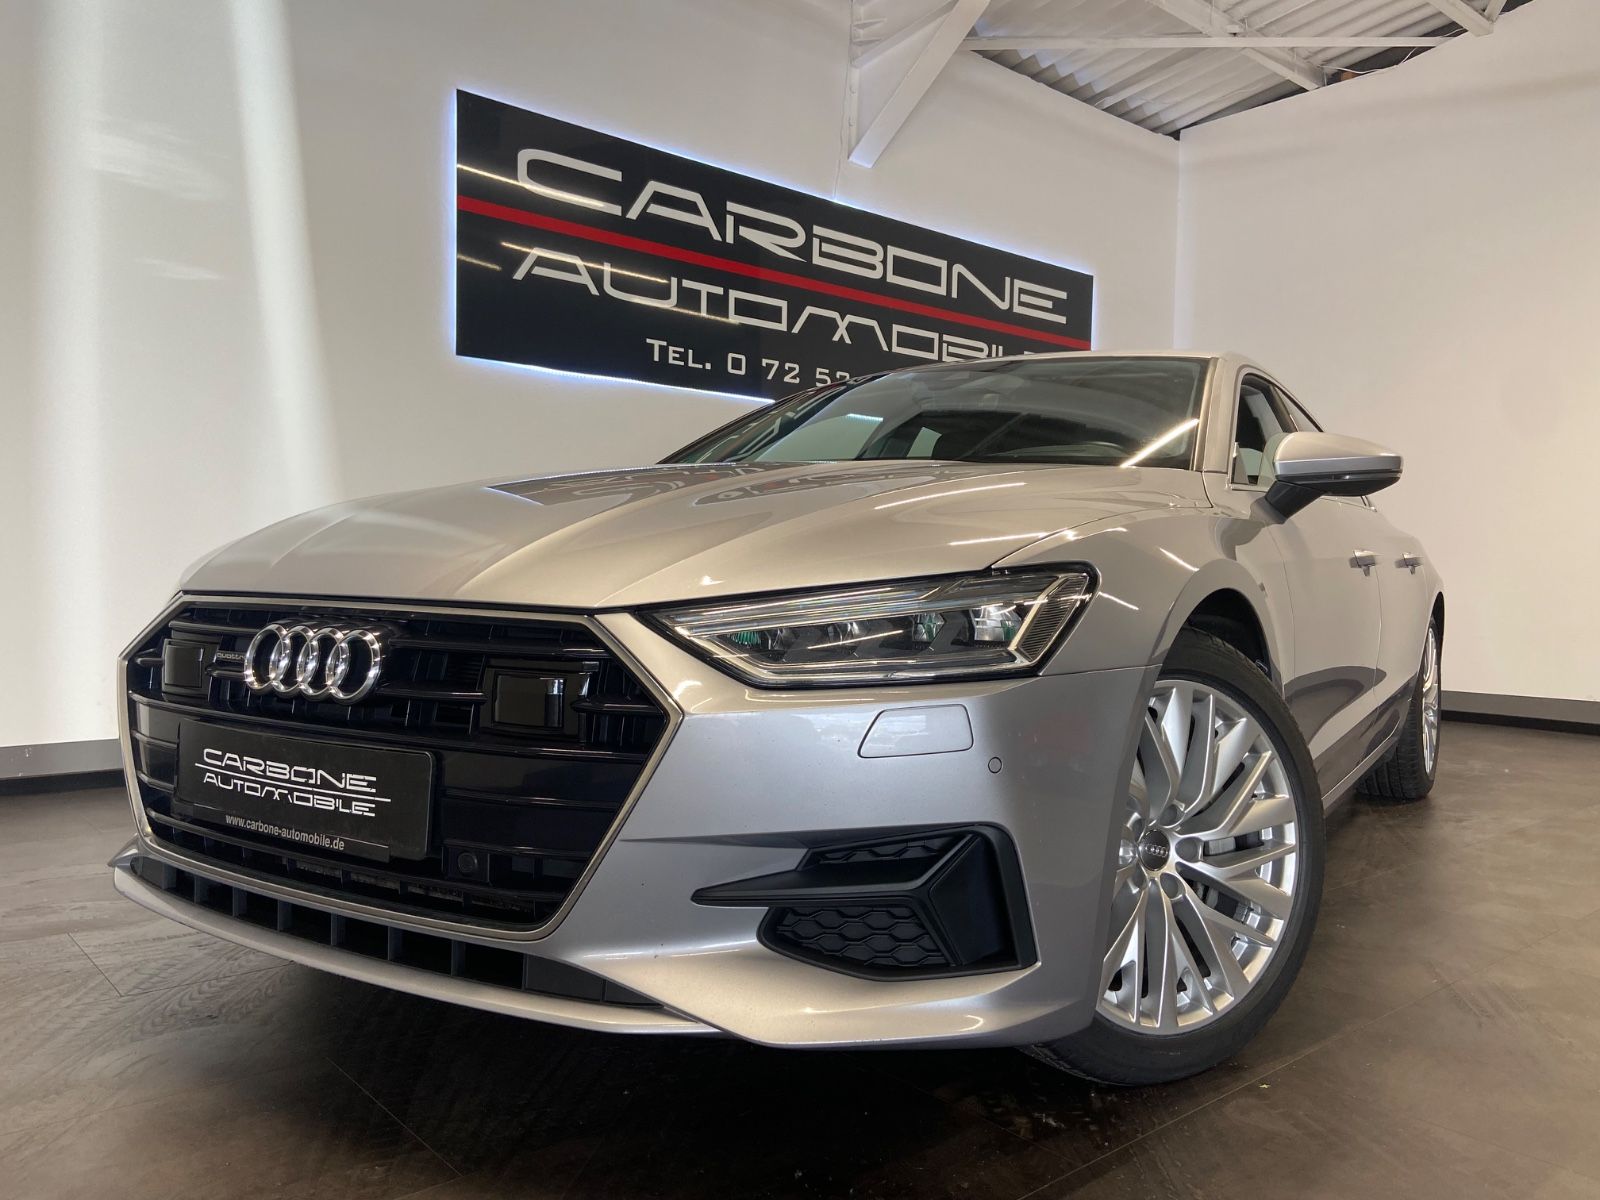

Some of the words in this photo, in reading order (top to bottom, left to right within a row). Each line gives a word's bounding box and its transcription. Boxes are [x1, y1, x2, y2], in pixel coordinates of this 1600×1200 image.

[517, 148, 1067, 325] CARBONE
[512, 247, 1036, 362] AUTOMOBI
[762, 358, 800, 384] 72
[216, 652, 246, 660] quattr
[203, 748, 376, 793] CARBONE
[203, 772, 376, 817] AUTOMOBILE
[225, 813, 345, 850] www.carbone-automobile.de
